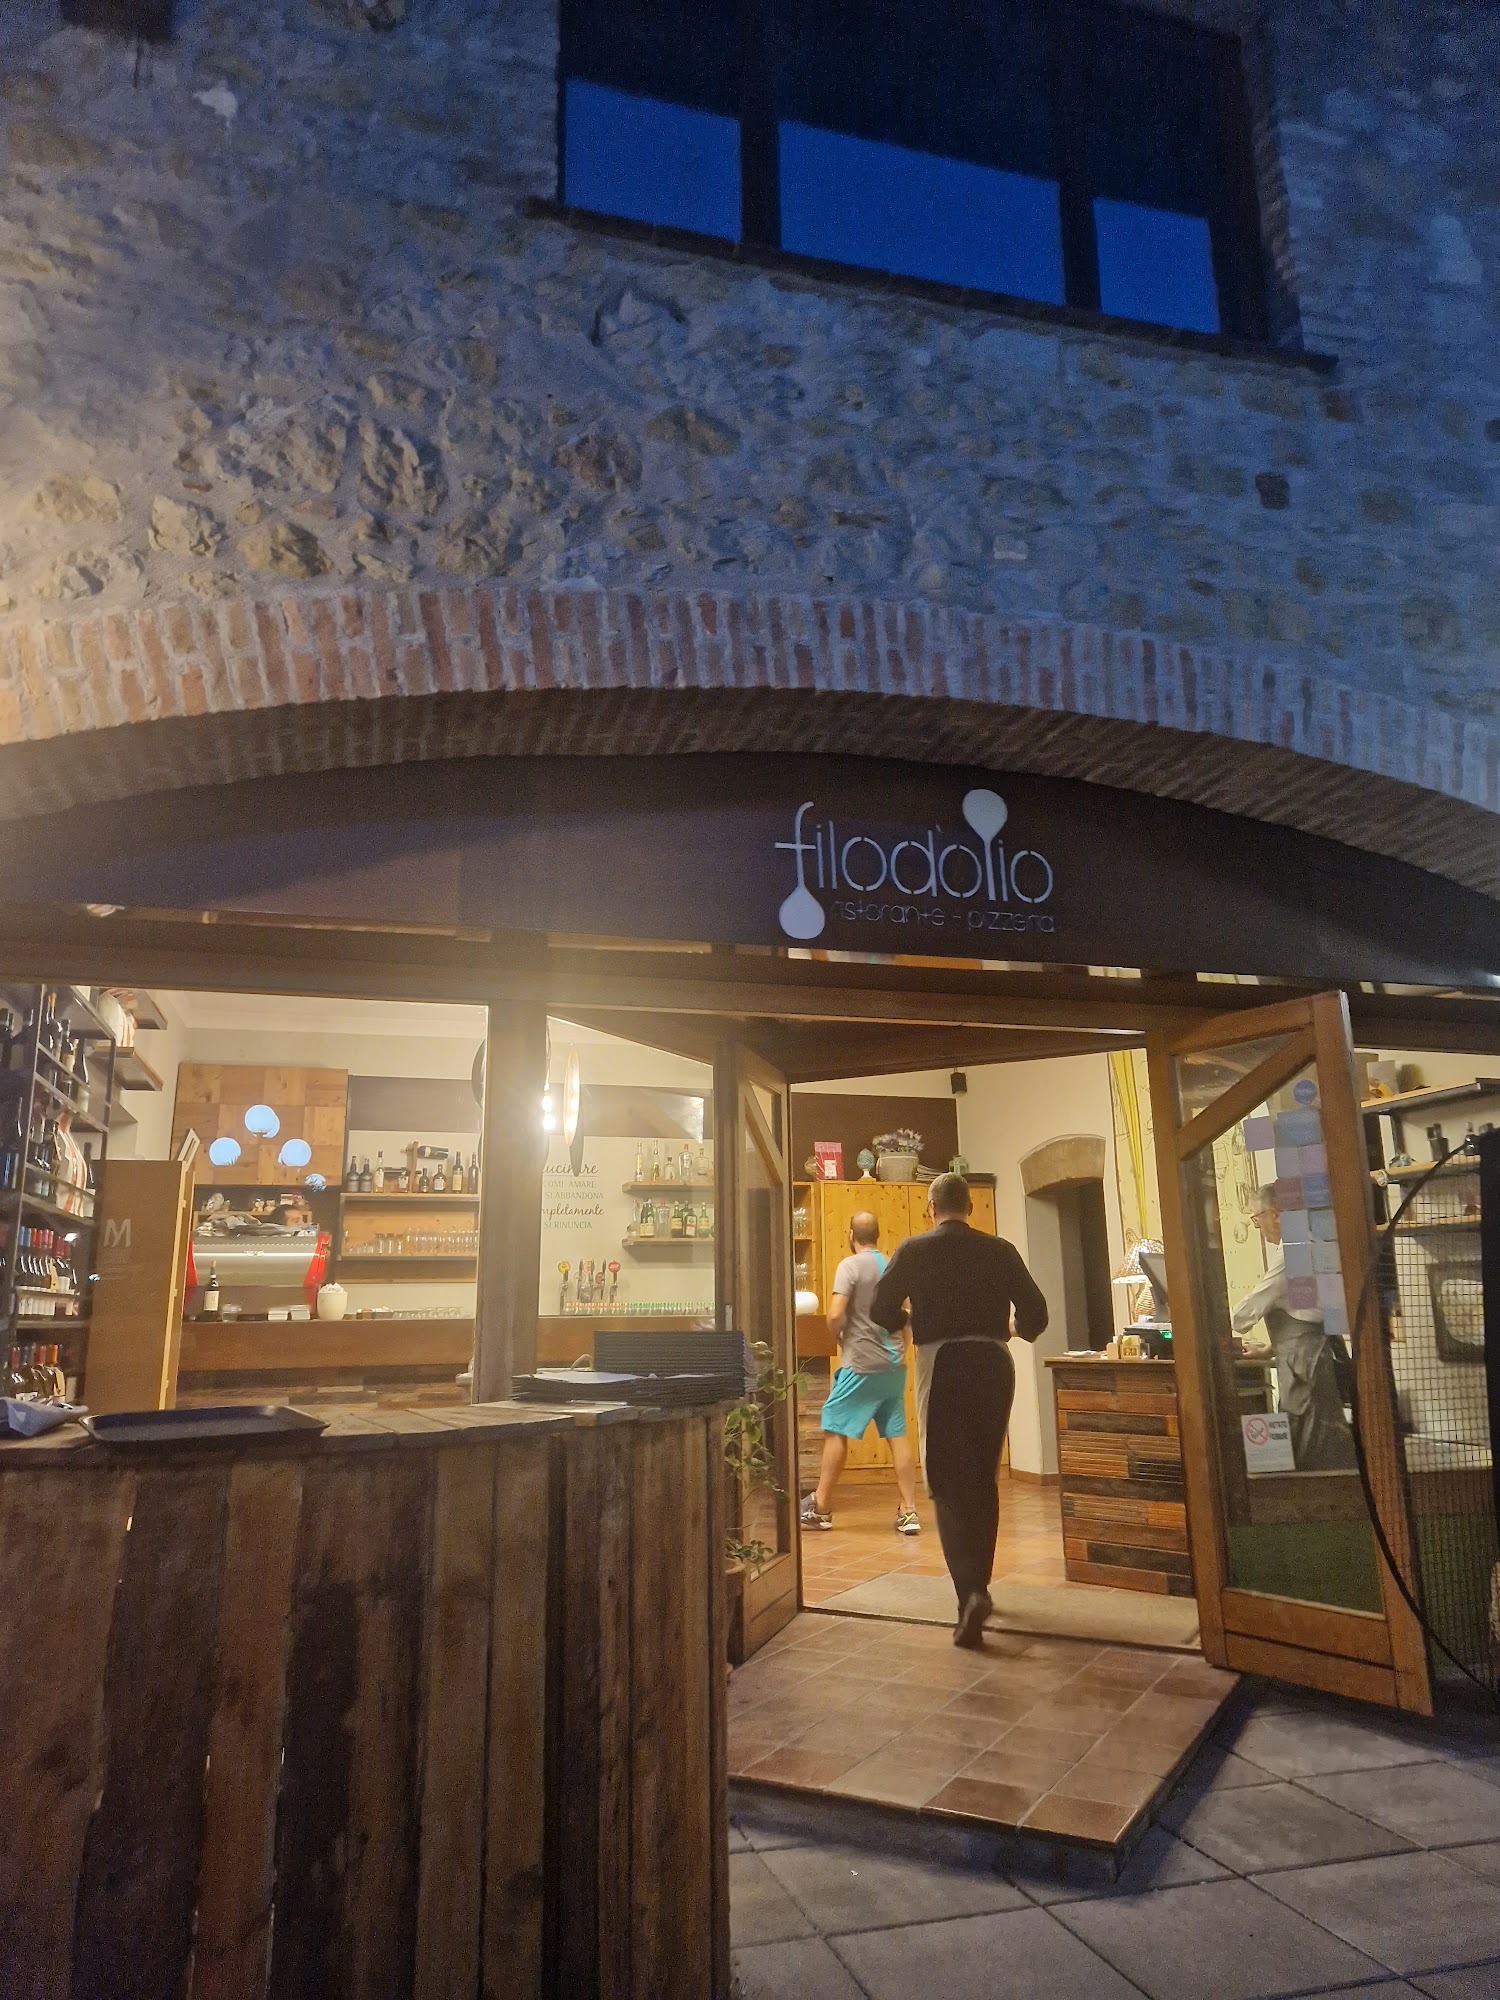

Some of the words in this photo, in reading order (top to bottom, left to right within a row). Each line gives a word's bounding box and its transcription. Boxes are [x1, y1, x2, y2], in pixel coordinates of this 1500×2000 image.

[831, 899, 945, 926] rstorante
[967, 910, 1055, 933] pzzera
[568, 1180, 597, 1189] AMARE
[555, 1191, 604, 1200] ABBANDONA
[554, 1221, 593, 1229] RINUNCIA
